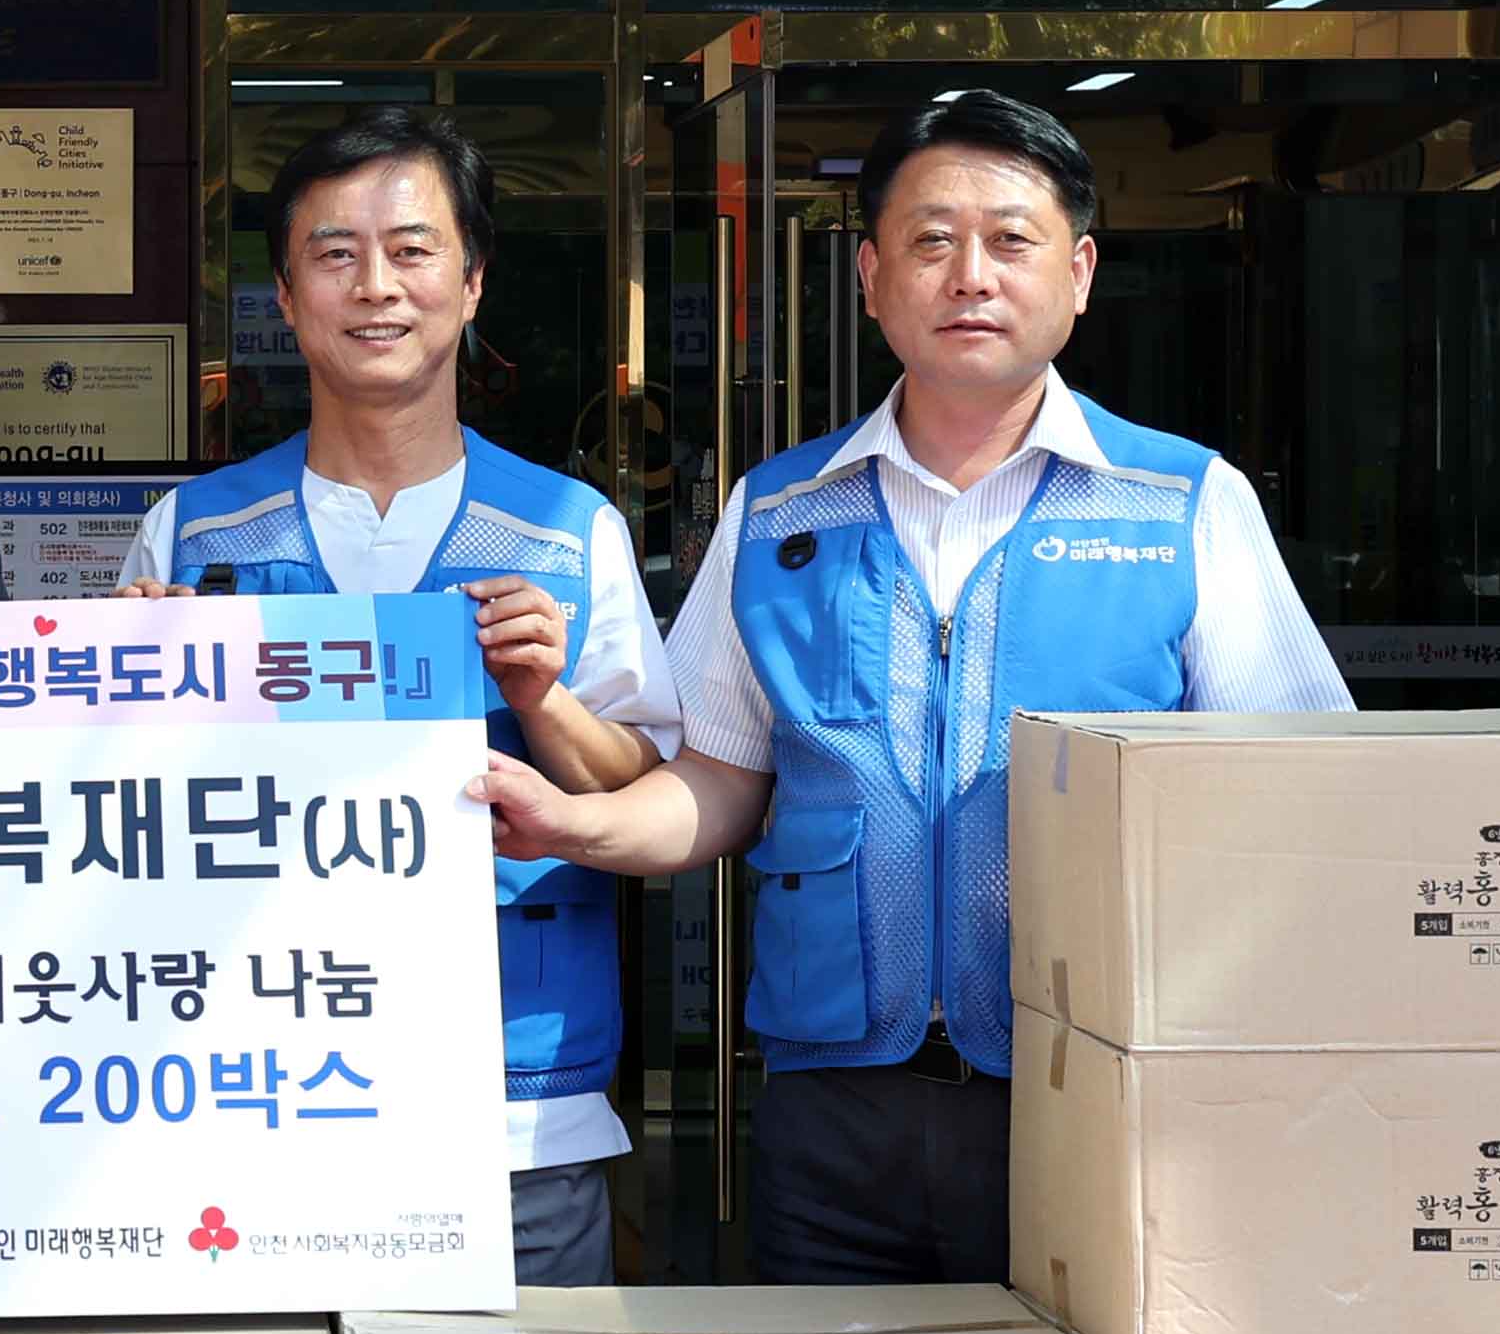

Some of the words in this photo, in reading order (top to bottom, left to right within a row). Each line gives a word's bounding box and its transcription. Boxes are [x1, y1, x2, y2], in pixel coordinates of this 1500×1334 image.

[58, 126, 84, 136] Child
[58, 138, 98, 148] Friendly
[58, 149, 86, 159] Cities
[58, 160, 104, 170] Initiative
[18, 255, 49, 266] unicef
[4, 423, 14, 435] is
[18, 423, 31, 435] to
[34, 423, 77, 437] certify
[80, 423, 105, 435] that
[38, 490, 51, 507] 및
[57, 490, 121, 507] 의회청사)
[40, 523, 67, 536] 502
[1069, 547, 1177, 564] 미래행복재단
[40, 572, 68, 585] 402
[254, 639, 433, 703] 동구!』
[248, 947, 379, 1021] 나눔
[37, 1046, 380, 1129] 200박스
[25, 1225, 165, 1260] 미래행복재단
[248, 1233, 288, 1257] 인천
[292, 1230, 465, 1260] 사회복지공동모금회
